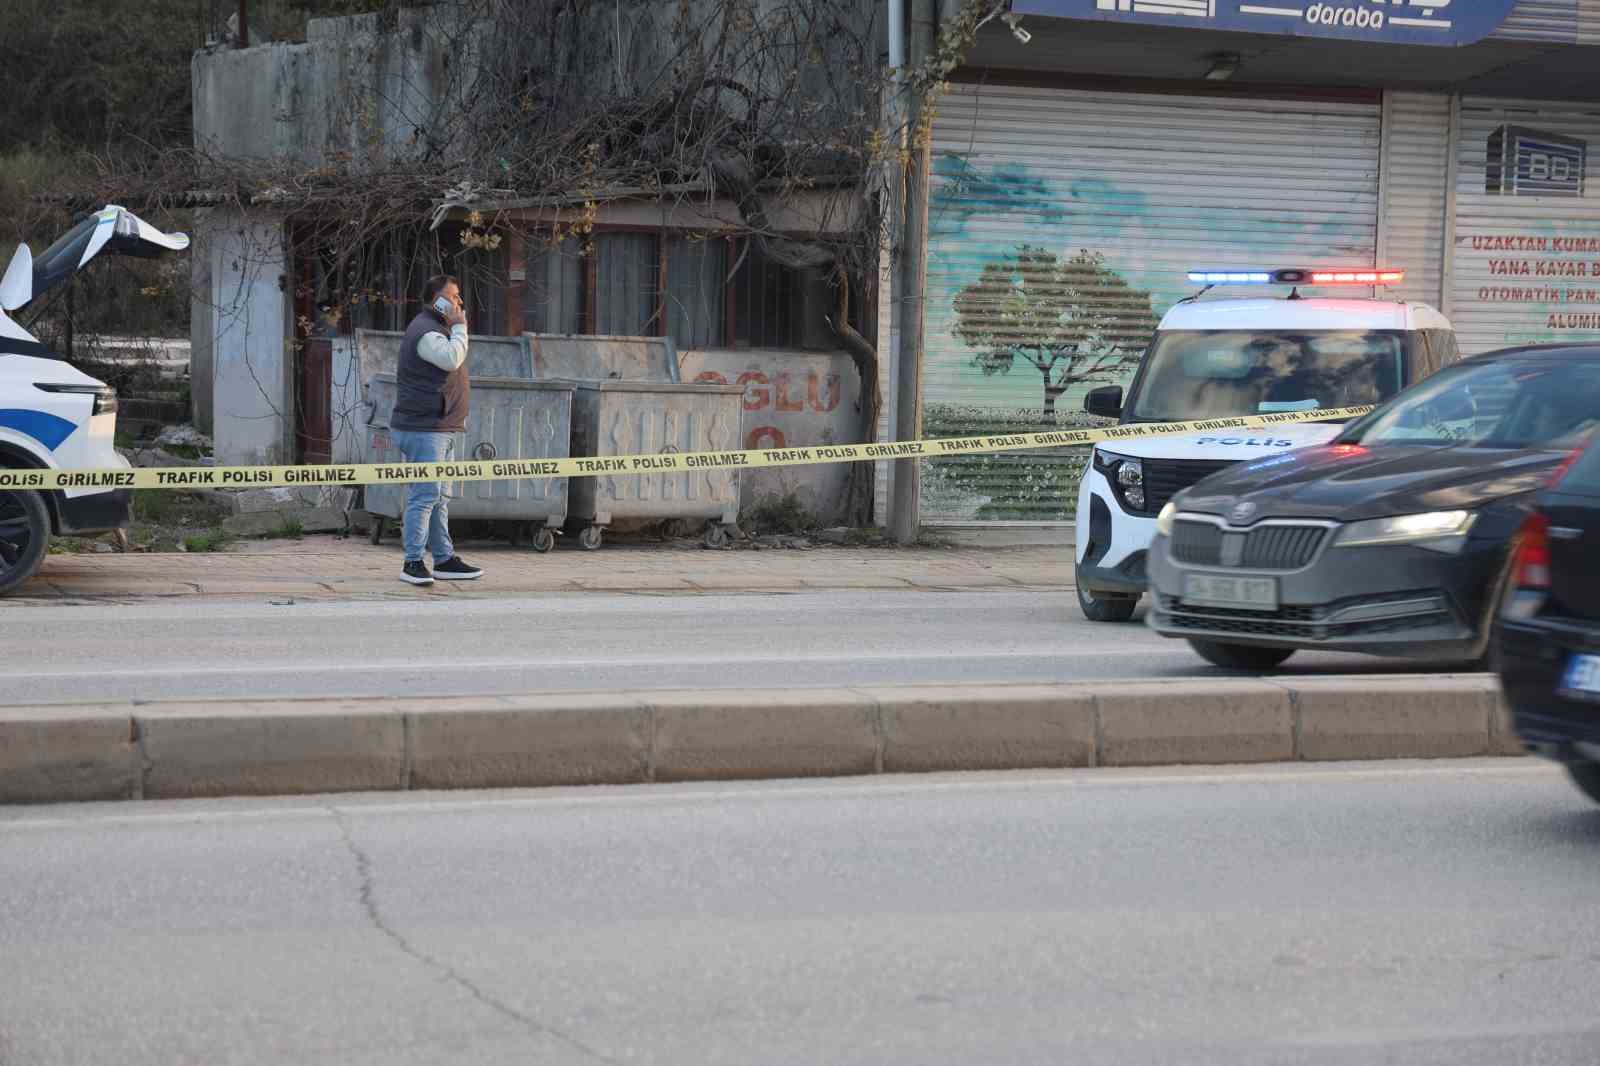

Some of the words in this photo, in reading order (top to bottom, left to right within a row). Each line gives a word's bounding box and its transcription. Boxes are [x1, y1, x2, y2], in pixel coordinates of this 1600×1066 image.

[1306, 3, 1383, 29] daraba
[1472, 235, 1547, 251] UZAKTAN
[1488, 259, 1530, 275] YANA
[1535, 261, 1586, 276] KAYAR
[1479, 284, 1559, 304] OTOMATİK
[1566, 287, 1600, 305] PAN
